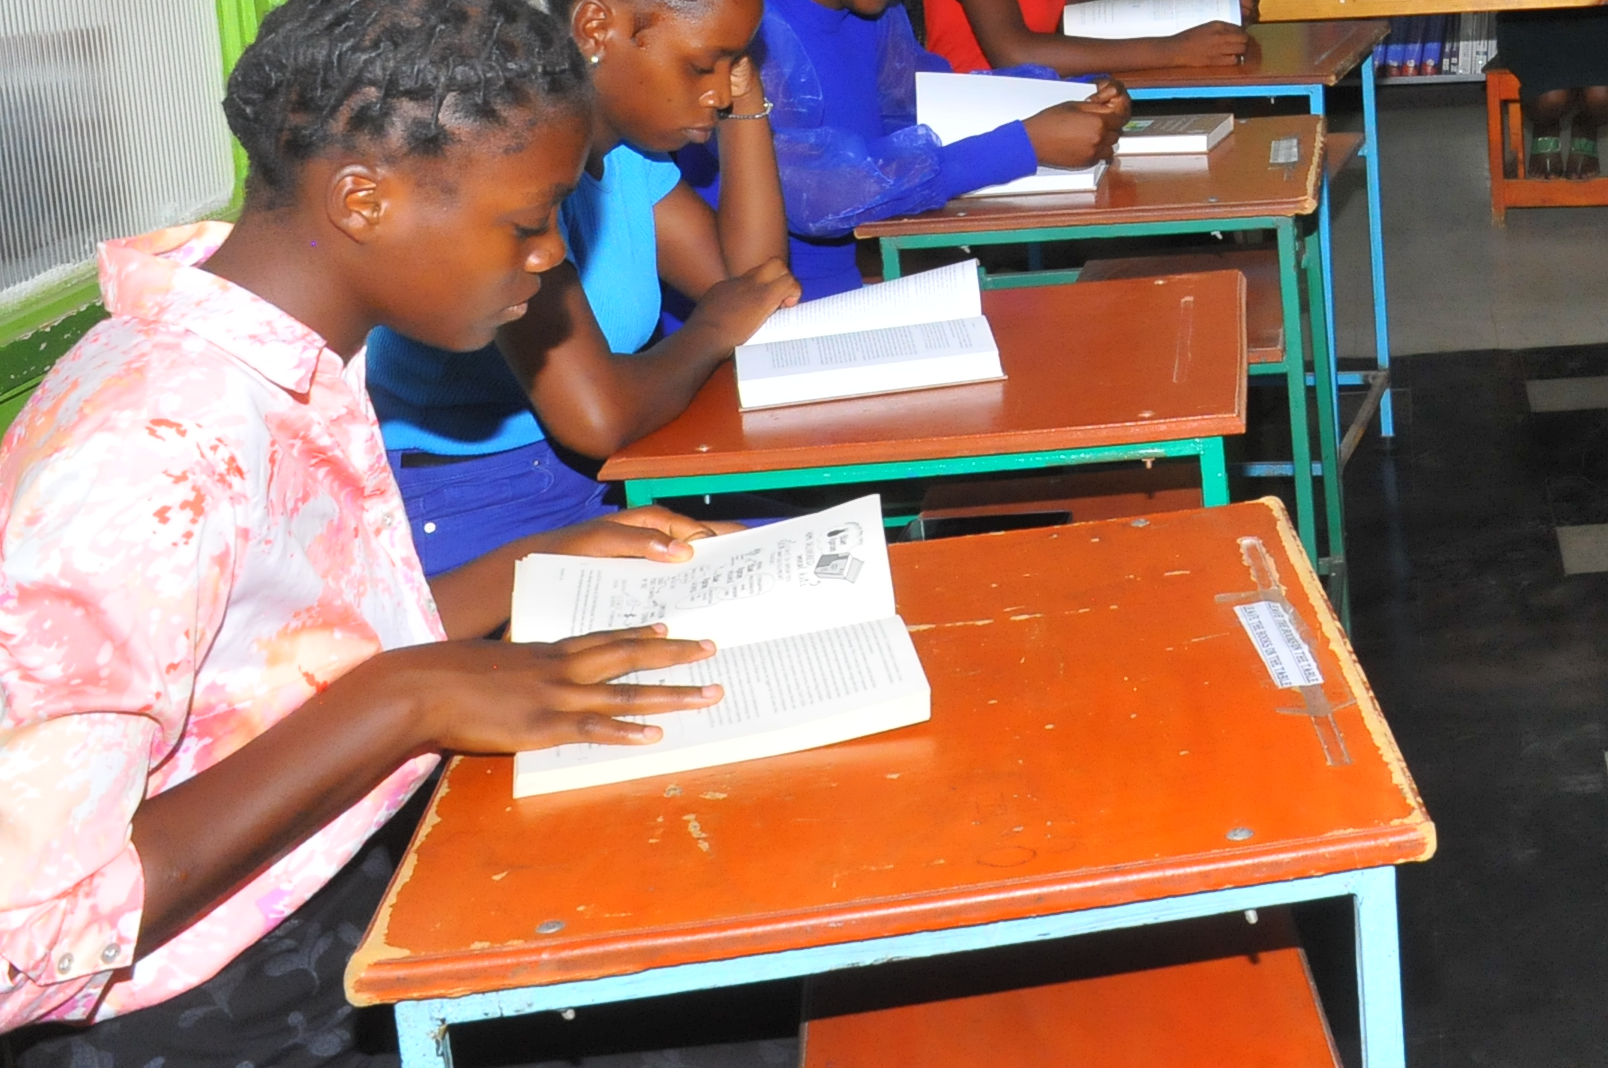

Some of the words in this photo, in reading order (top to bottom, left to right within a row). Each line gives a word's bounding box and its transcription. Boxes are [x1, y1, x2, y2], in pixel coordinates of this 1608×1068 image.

[1251, 620, 1265, 631] THE
[1256, 630, 1273, 648] BOOKS
[1264, 647, 1276, 656] ON
[1294, 651, 1309, 664] THE
[1268, 655, 1283, 668] THE
[1274, 666, 1293, 687] TABLE
[1301, 664, 1319, 684] TABLE
